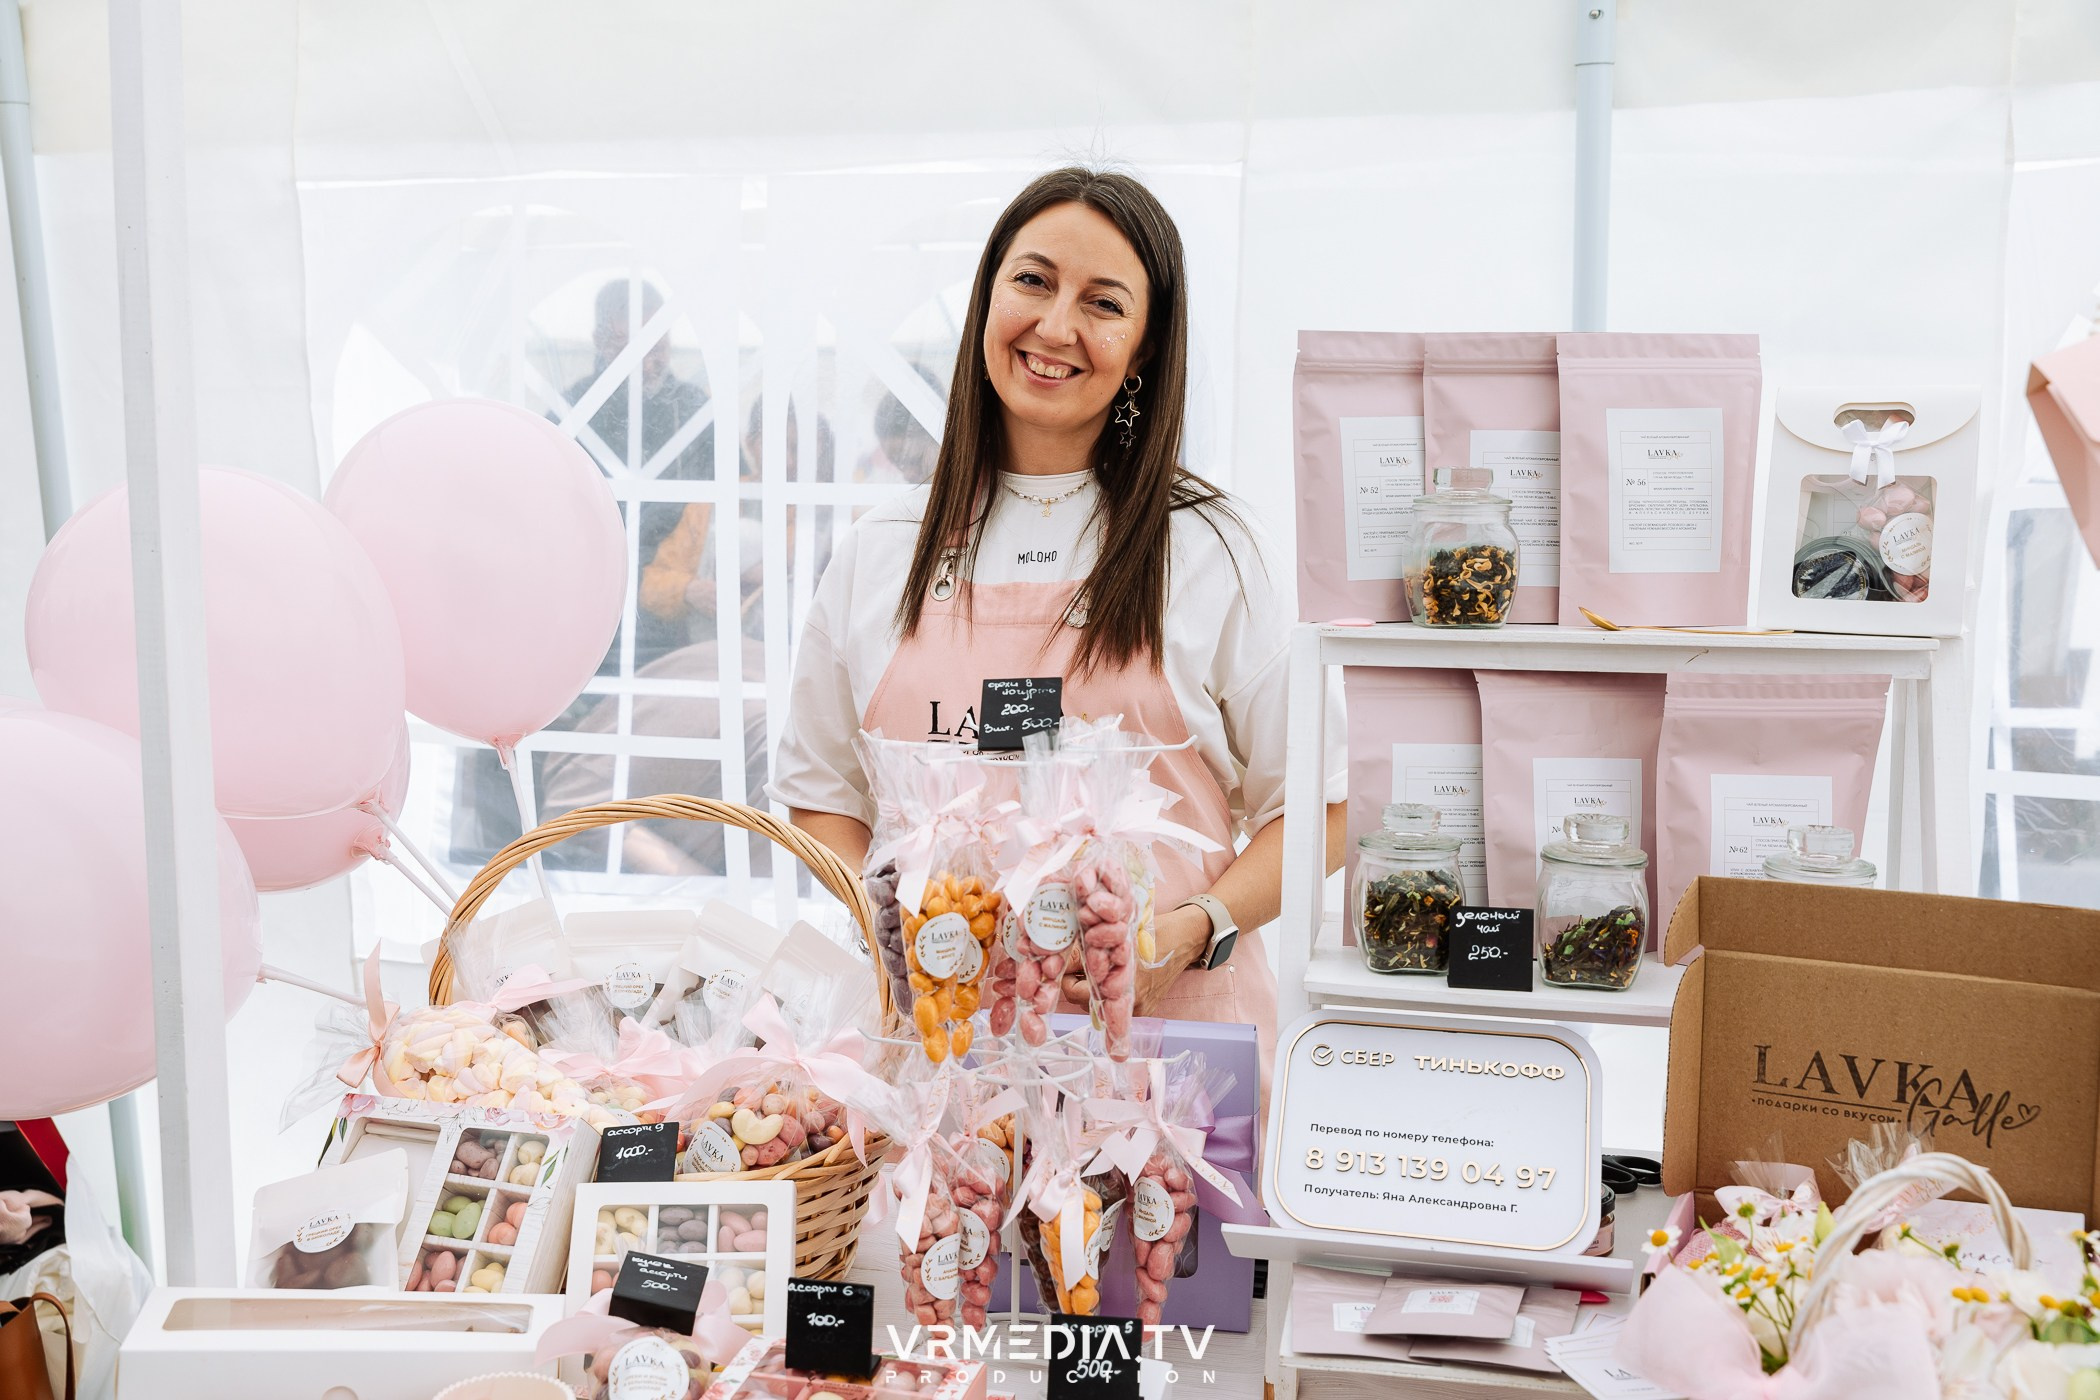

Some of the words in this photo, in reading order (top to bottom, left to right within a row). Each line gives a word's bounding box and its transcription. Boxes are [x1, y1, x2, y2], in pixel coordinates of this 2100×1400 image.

[1370, 486, 1379, 494] 52
[1892, 527, 1920, 543] LAVKA
[1017, 550, 1058, 565] MOLOKO
[1039, 899, 1070, 911] LAVKA
[1455, 910, 1521, 928] зеленый
[1476, 924, 1501, 934] чай
[1468, 944, 1509, 961] 250.-
[1340, 1049, 1395, 1067] СБЕР
[1414, 1055, 1565, 1080] ТИНЬКОФФ
[1752, 1044, 1982, 1114] LAVKA
[1757, 1098, 1817, 1113] подарки
[1822, 1106, 1839, 1117] со
[1843, 1109, 1896, 1124] вкусом
[1310, 1123, 1362, 1137] Перевод
[1365, 1128, 1380, 1137] по
[1383, 1131, 1429, 1143] номеру
[1432, 1134, 1494, 1148] телефона:
[1305, 1147, 1325, 1170] 8
[1335, 1149, 1387, 1176] 913
[1397, 1154, 1449, 1181] 139
[1461, 1160, 1505, 1187] 04
[1516, 1165, 1557, 1190] 97
[1304, 1183, 1380, 1200] Получатель:
[1382, 1191, 1405, 1203] Яна
[1408, 1194, 1507, 1213] Александровна
[1510, 1204, 1518, 1213] Г.
[842, 1285, 854, 1296] 6
[625, 1354, 665, 1369] LAVKA
